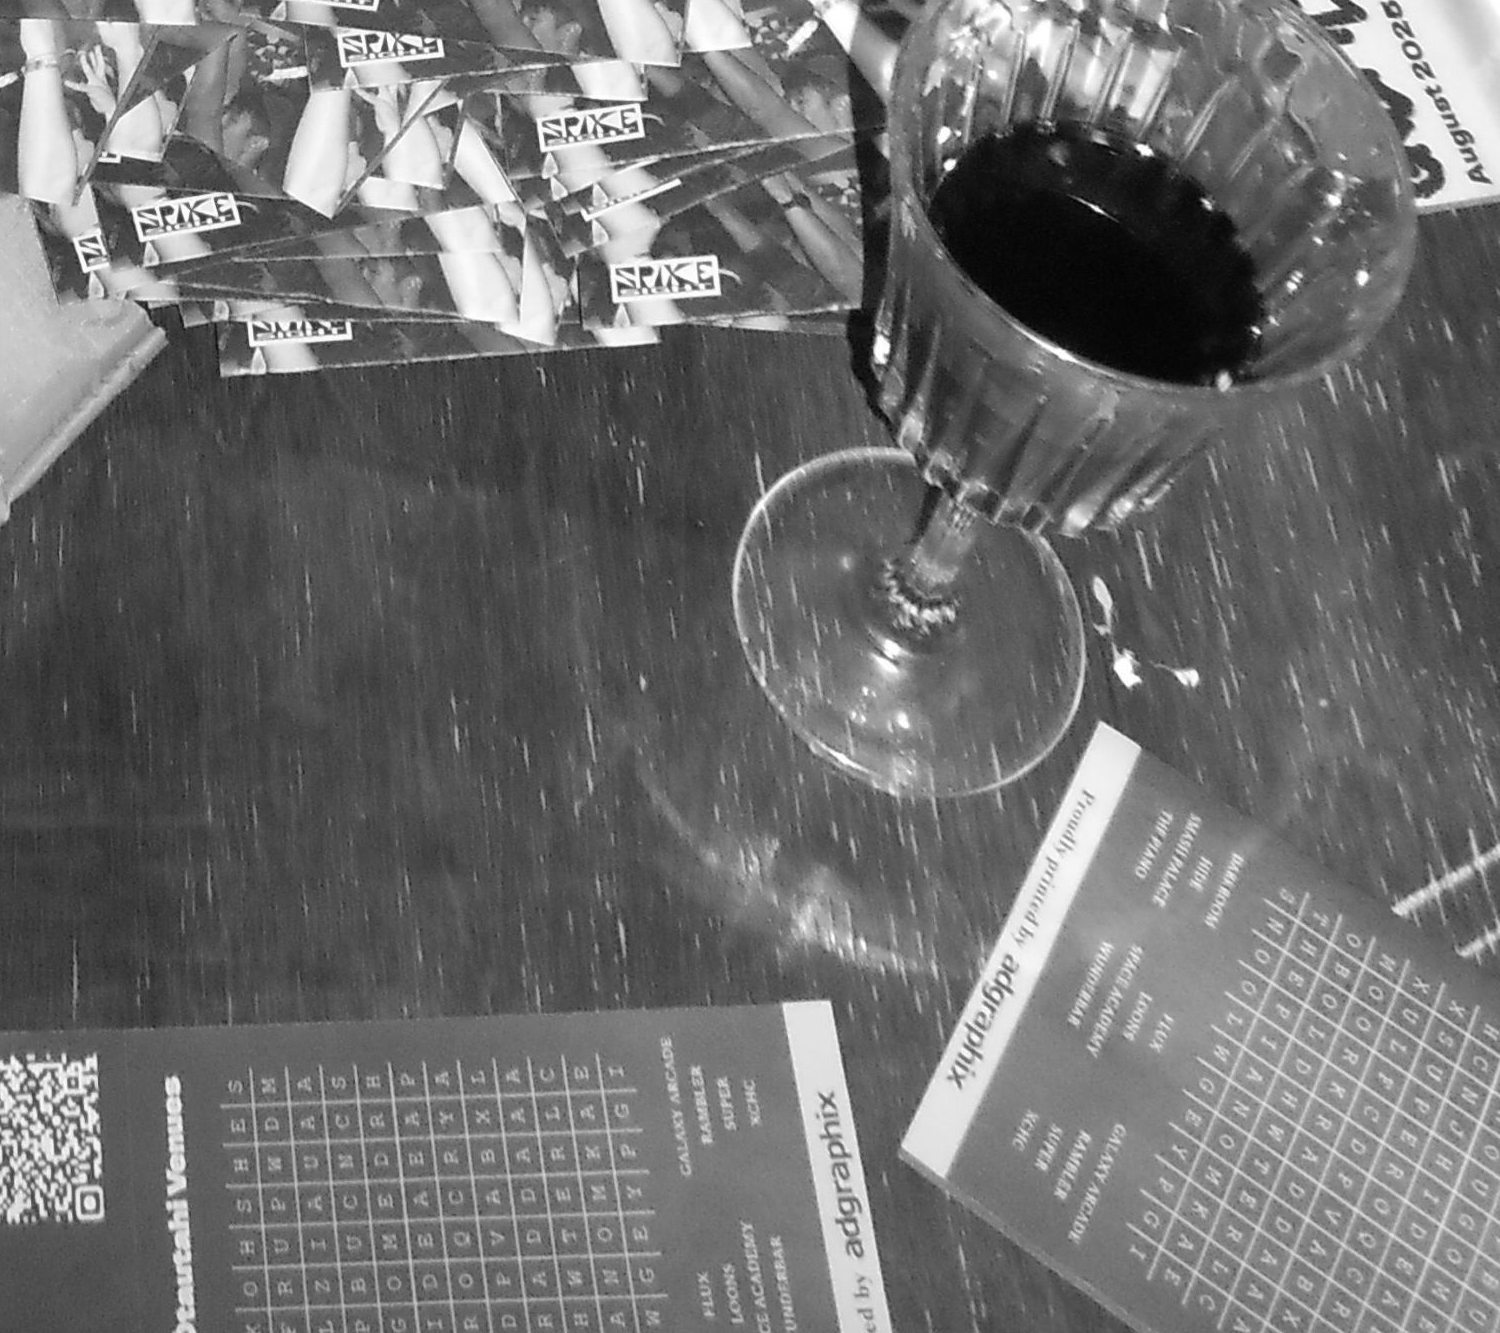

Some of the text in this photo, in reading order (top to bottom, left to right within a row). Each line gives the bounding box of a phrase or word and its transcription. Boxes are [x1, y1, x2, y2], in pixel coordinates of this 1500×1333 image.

[1379, 0, 1435, 80] 2025
[1424, 84, 1493, 187] August
[947, 788, 1097, 1091] Proudly printed by adgraphix
[1067, 941, 1115, 1029] WUNDERBAR
[1086, 943, 1144, 1059] SPACE ACADEMY
[1123, 991, 1153, 1041] LOONS
[1149, 1012, 1174, 1054] FLUX
[660, 1036, 692, 1177] GALAXY ARCADE
[691, 1064, 714, 1145] RAMBLER
[717, 1076, 737, 1132] SUPER
[744, 1079, 761, 1126] XCHC
[818, 1090, 866, 1259] adgraphix
[1034, 1123, 1063, 1172] SUPER
[1053, 1130, 1092, 1202] RAMBLER
[1067, 1123, 1127, 1245] GALAXY ARCADE
[696, 1271, 716, 1318] FLUX
[722, 1263, 744, 1324] LOONS
[739, 1221, 769, 1309] ACADEMY
[854, 1274, 873, 1298] by
